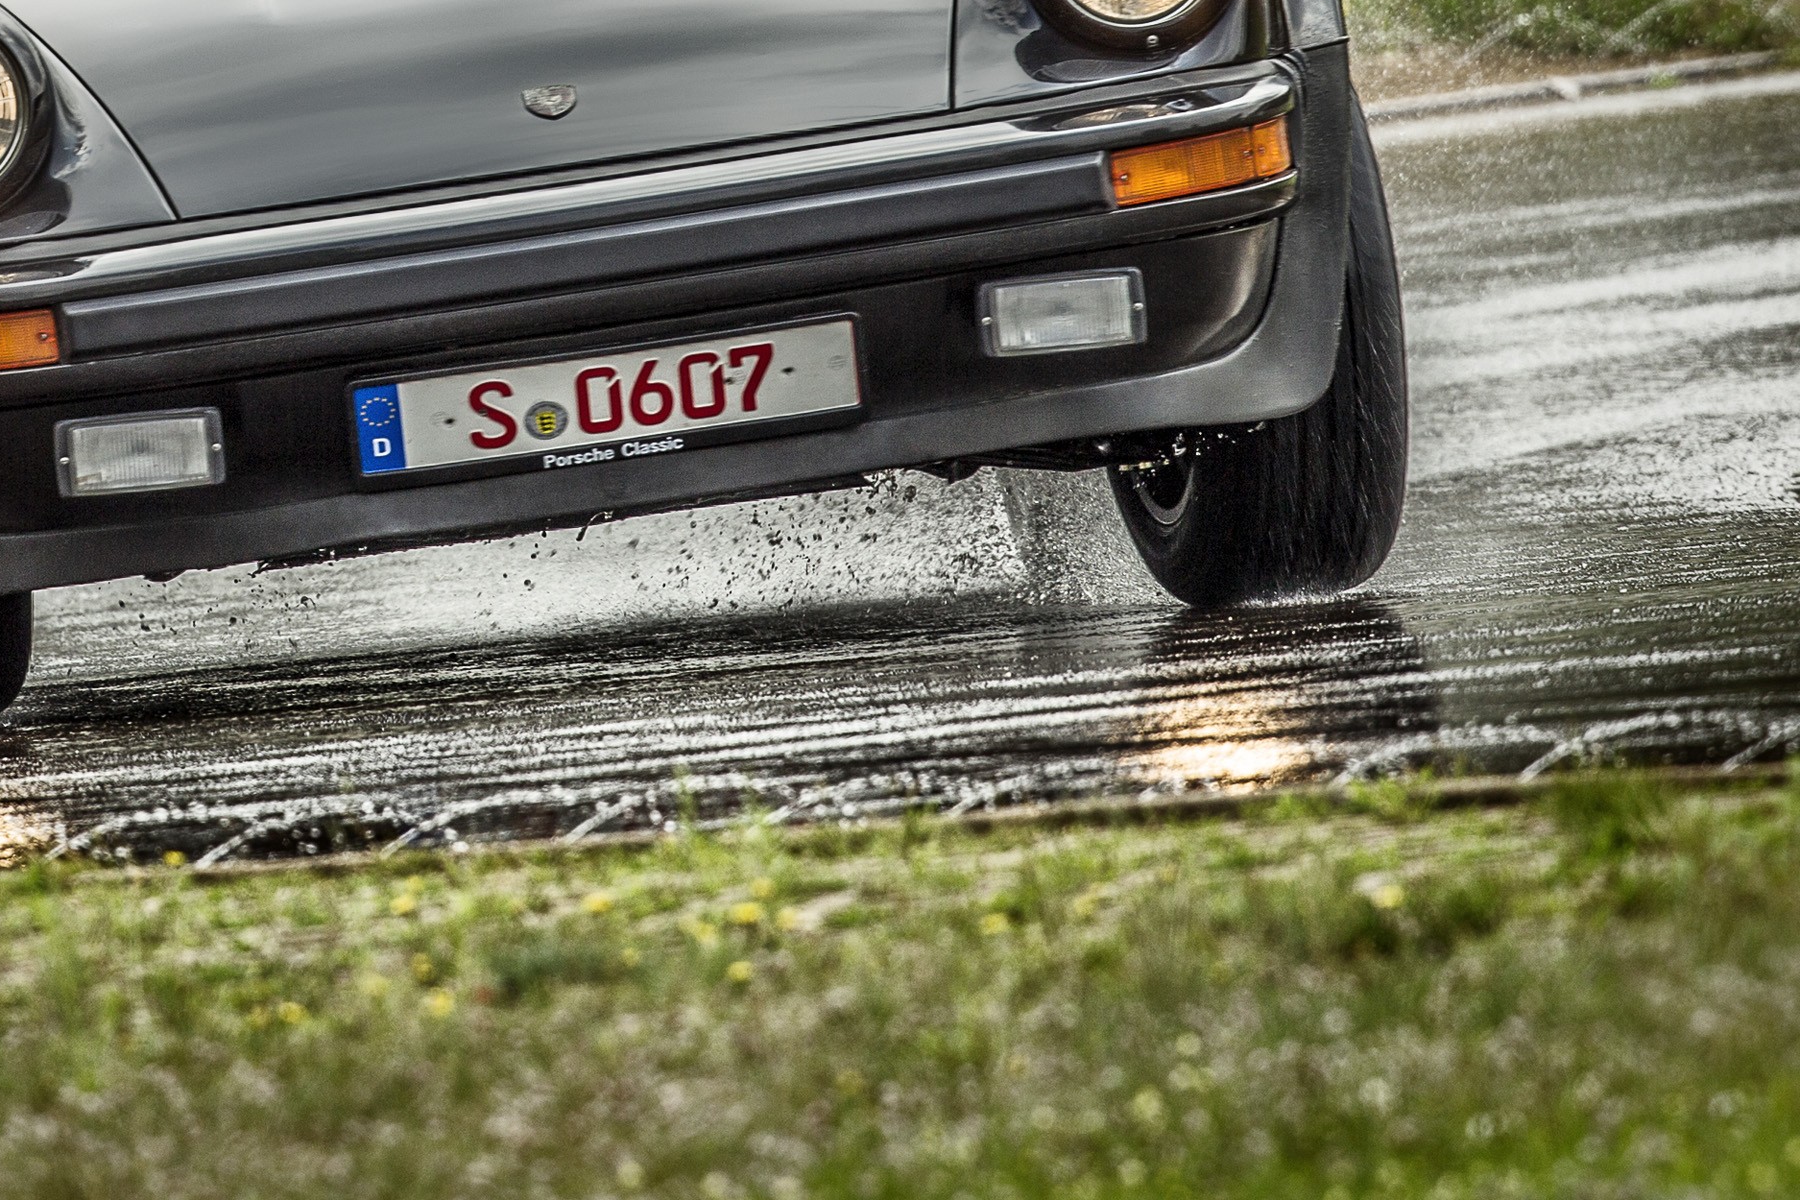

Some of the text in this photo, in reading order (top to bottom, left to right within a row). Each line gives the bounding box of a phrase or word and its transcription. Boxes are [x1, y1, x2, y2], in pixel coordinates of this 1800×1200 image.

[469, 343, 774, 450] S 0607
[373, 438, 391, 456] D
[543, 437, 684, 469] Porsche Classic
